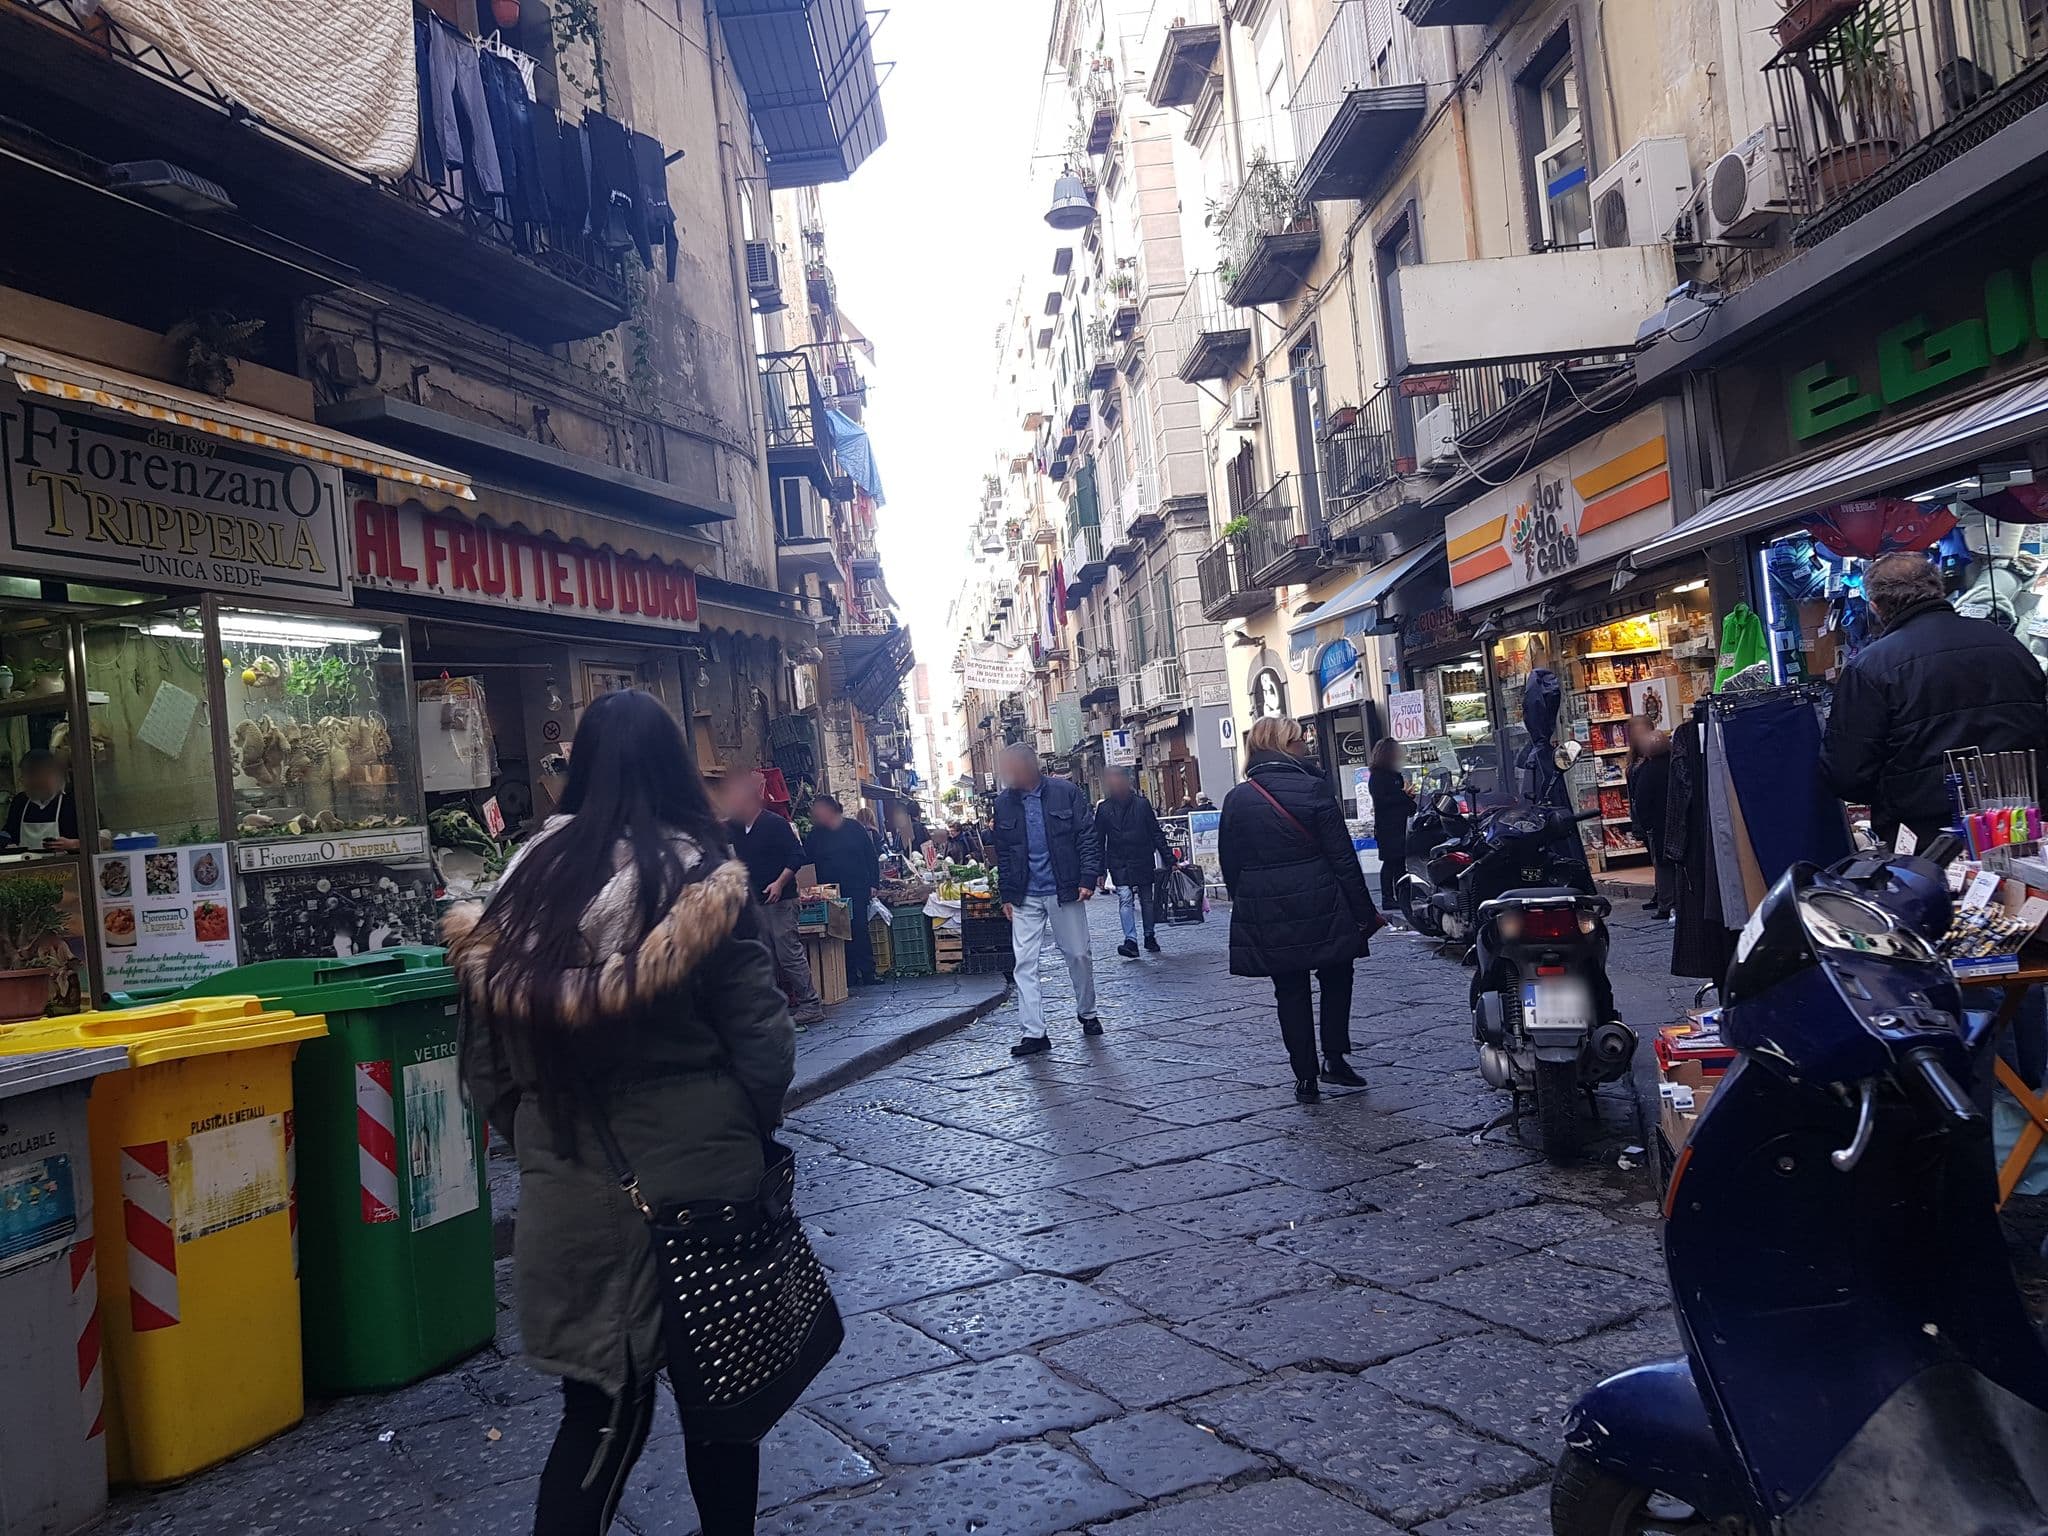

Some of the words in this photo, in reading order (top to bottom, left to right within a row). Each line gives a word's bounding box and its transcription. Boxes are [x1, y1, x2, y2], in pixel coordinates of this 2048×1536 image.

[148, 428, 175, 450] dal
[181, 434, 218, 459] 1897
[28, 469, 327, 574] TRIPPERIA
[1535, 511, 1557, 547] do
[140, 553, 207, 581] UNICA
[212, 565, 263, 588] SEDE
[355, 500, 419, 582] AL
[422, 513, 613, 611] FRUTTETO
[967, 662, 1005, 671] DEPOSITARE
[1401, 703, 1422, 715] STOCCO
[338, 838, 400, 858] TRIPPERIA
[191, 1116, 229, 1135] PLASTICA
[229, 1113, 234, 1125] E
[235, 1105, 265, 1123] METALLI
